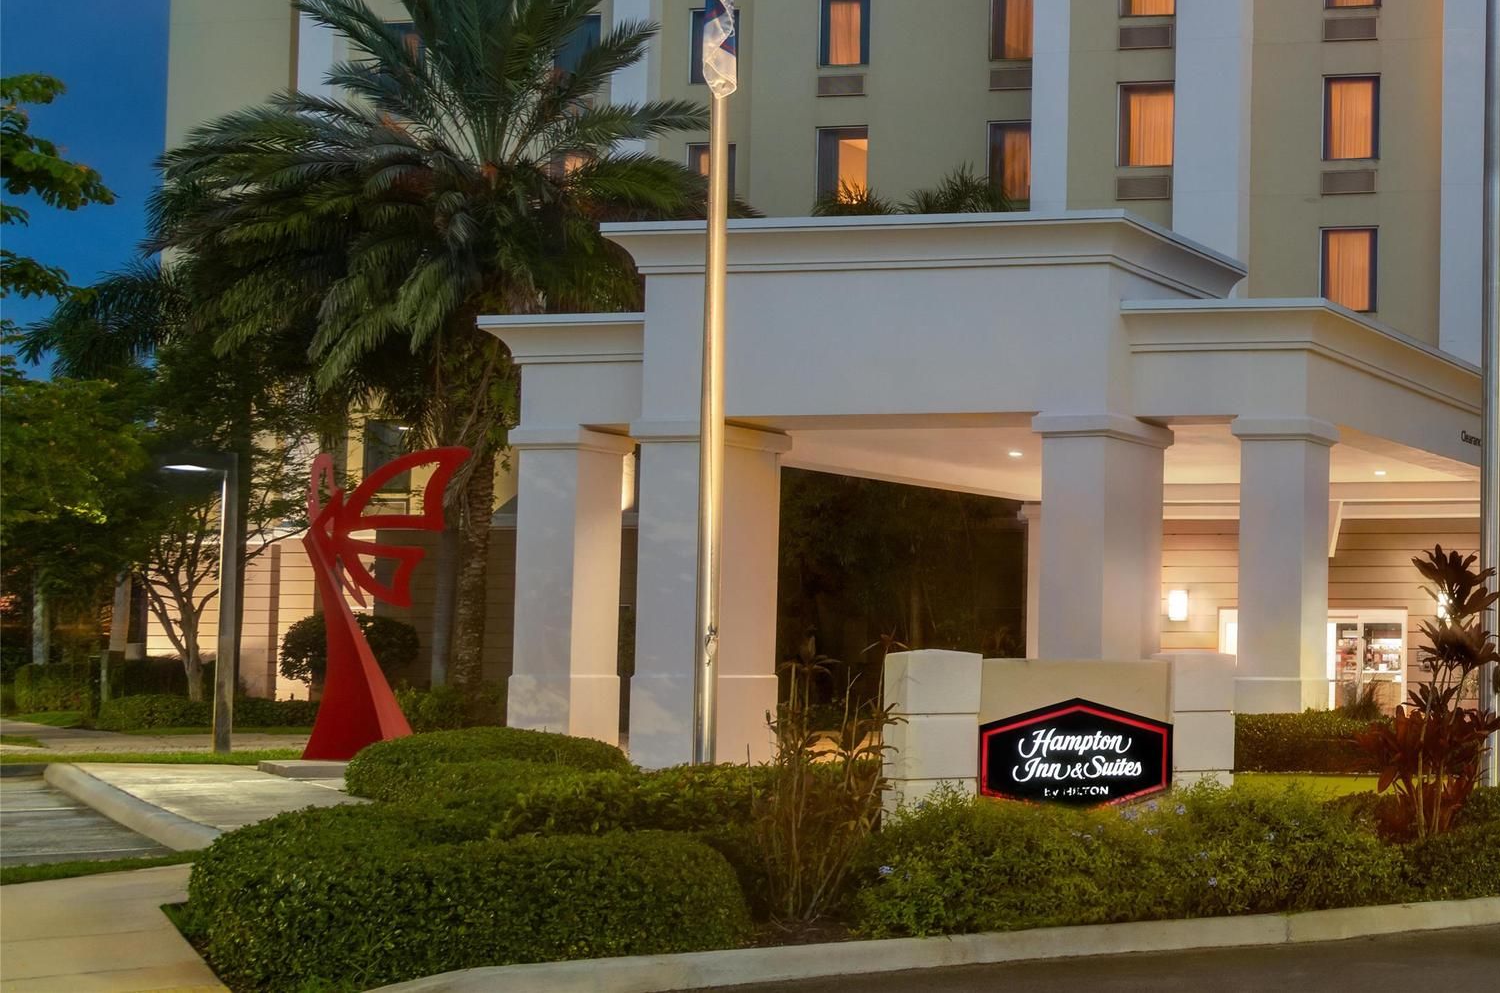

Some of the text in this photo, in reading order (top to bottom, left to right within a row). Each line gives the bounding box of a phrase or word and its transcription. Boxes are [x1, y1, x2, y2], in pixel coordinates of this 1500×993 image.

[1018, 727, 1132, 759] Hampton
[1012, 755, 1142, 782] Inn & Suites
